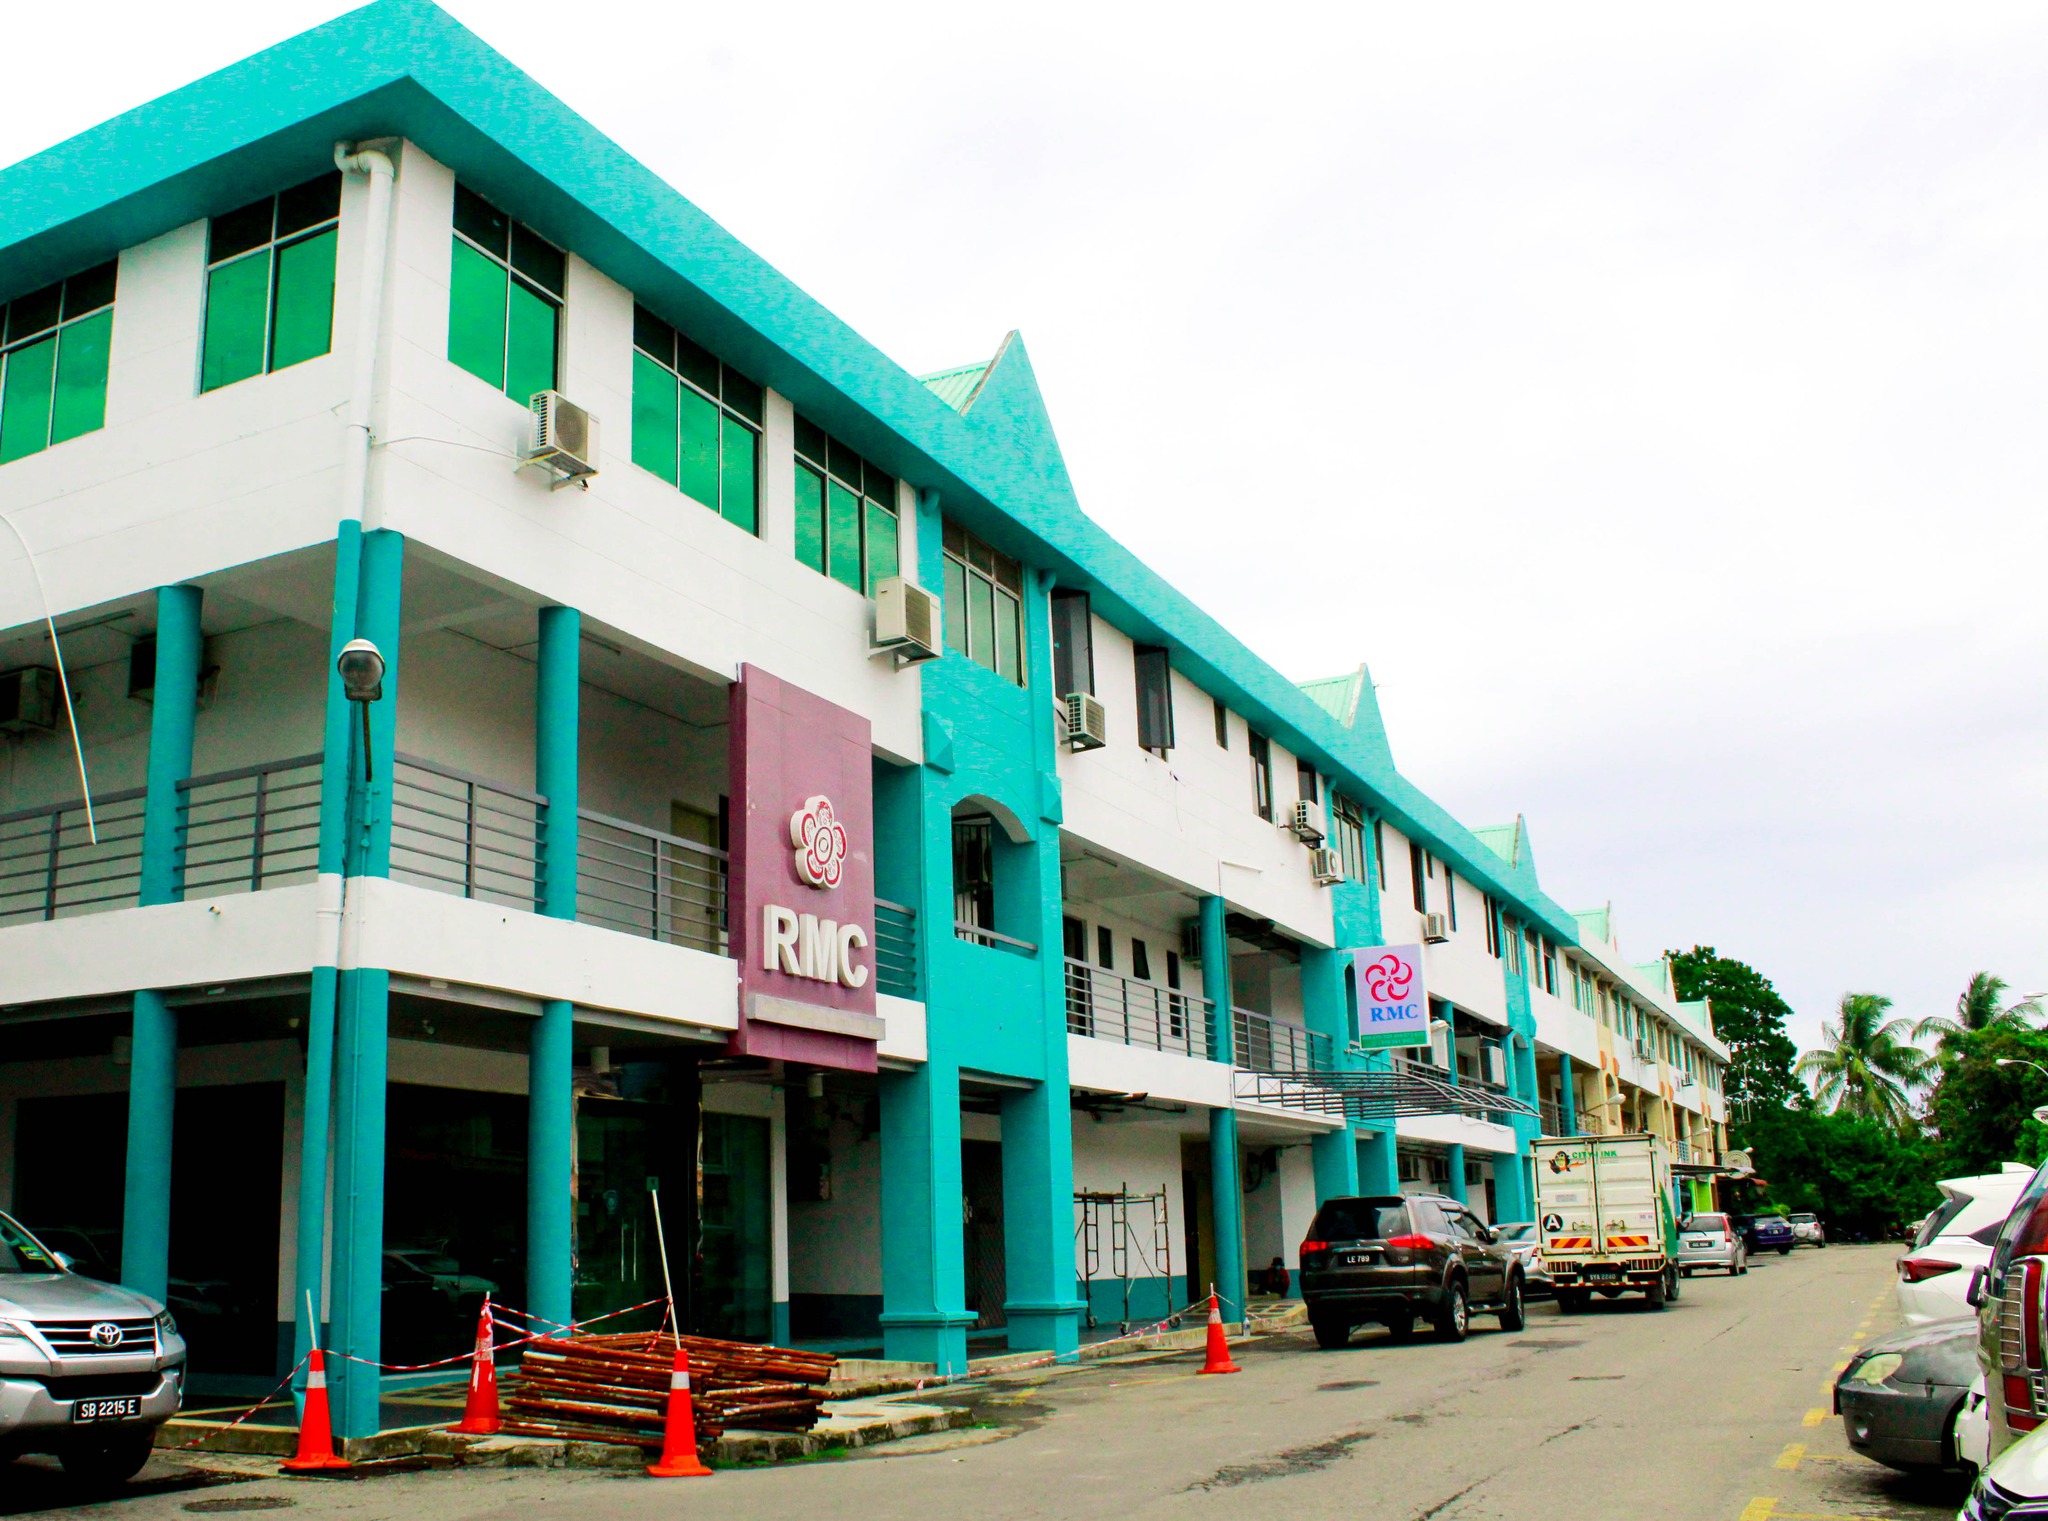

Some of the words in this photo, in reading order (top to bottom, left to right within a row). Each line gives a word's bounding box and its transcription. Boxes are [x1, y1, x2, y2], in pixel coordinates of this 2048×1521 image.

[763, 904, 869, 988] RMC
[1370, 1004, 1418, 1022] RMC
[1545, 1214, 1561, 1230] A
[1347, 1255, 1356, 1264] LE
[81, 1403, 96, 1418] SB
[98, 1401, 125, 1416] 2215
[127, 1399, 136, 1414] E
